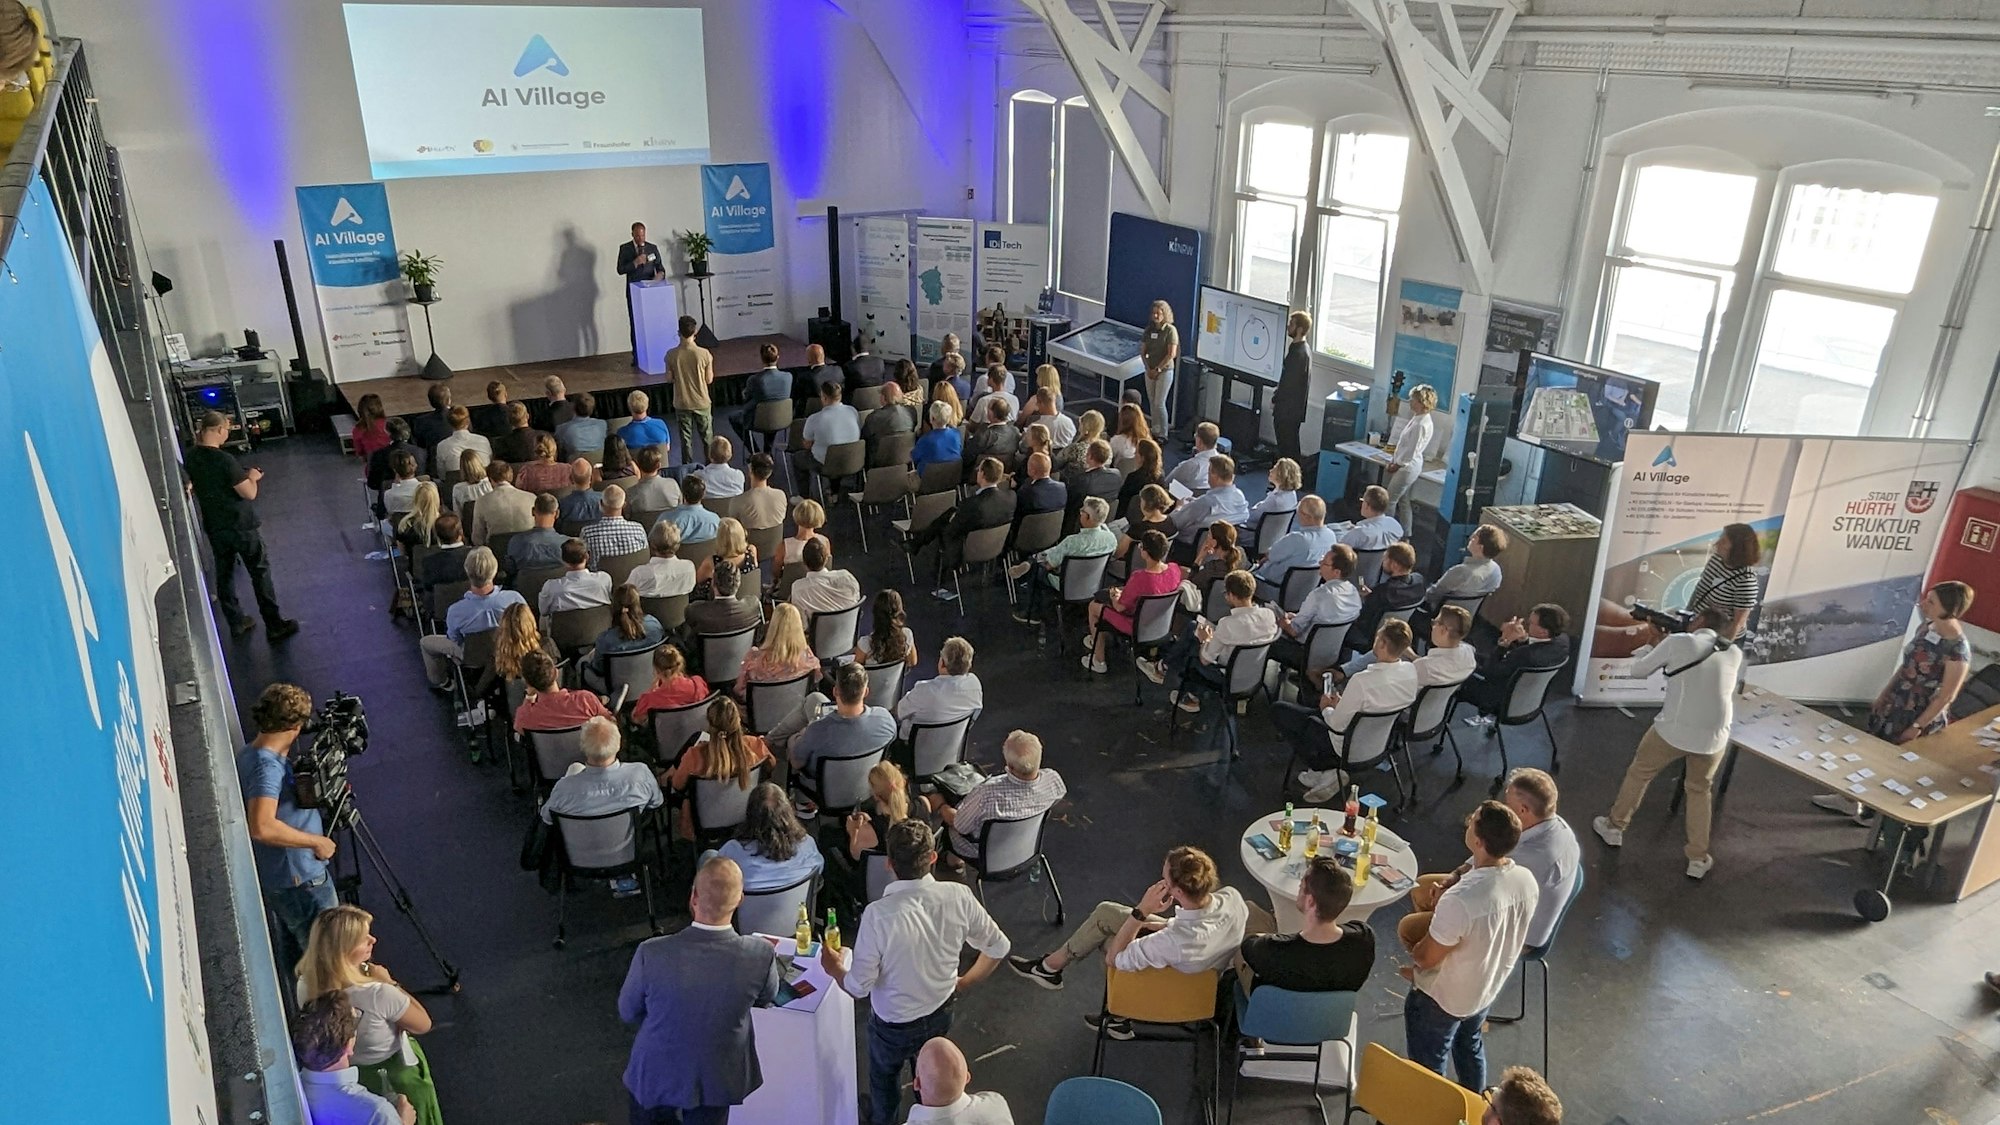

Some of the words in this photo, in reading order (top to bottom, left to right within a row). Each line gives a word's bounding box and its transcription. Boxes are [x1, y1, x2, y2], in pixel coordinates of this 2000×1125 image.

[481, 88, 508, 107] AI
[515, 87, 606, 110] Village
[711, 206, 723, 218] AI
[725, 204, 767, 218] Village
[315, 233, 330, 246] AI
[332, 230, 386, 246] Village
[1633, 472, 1646, 482] AI
[1649, 471, 1690, 484] Village
[1868, 491, 1900, 501] STADT
[1845, 499, 1896, 515] HÜRTH
[1832, 516, 1921, 534] STRUKTUR
[1846, 534, 1914, 551] WANDEL
[113, 660, 146, 882] Village
[119, 831, 154, 1002] AI
